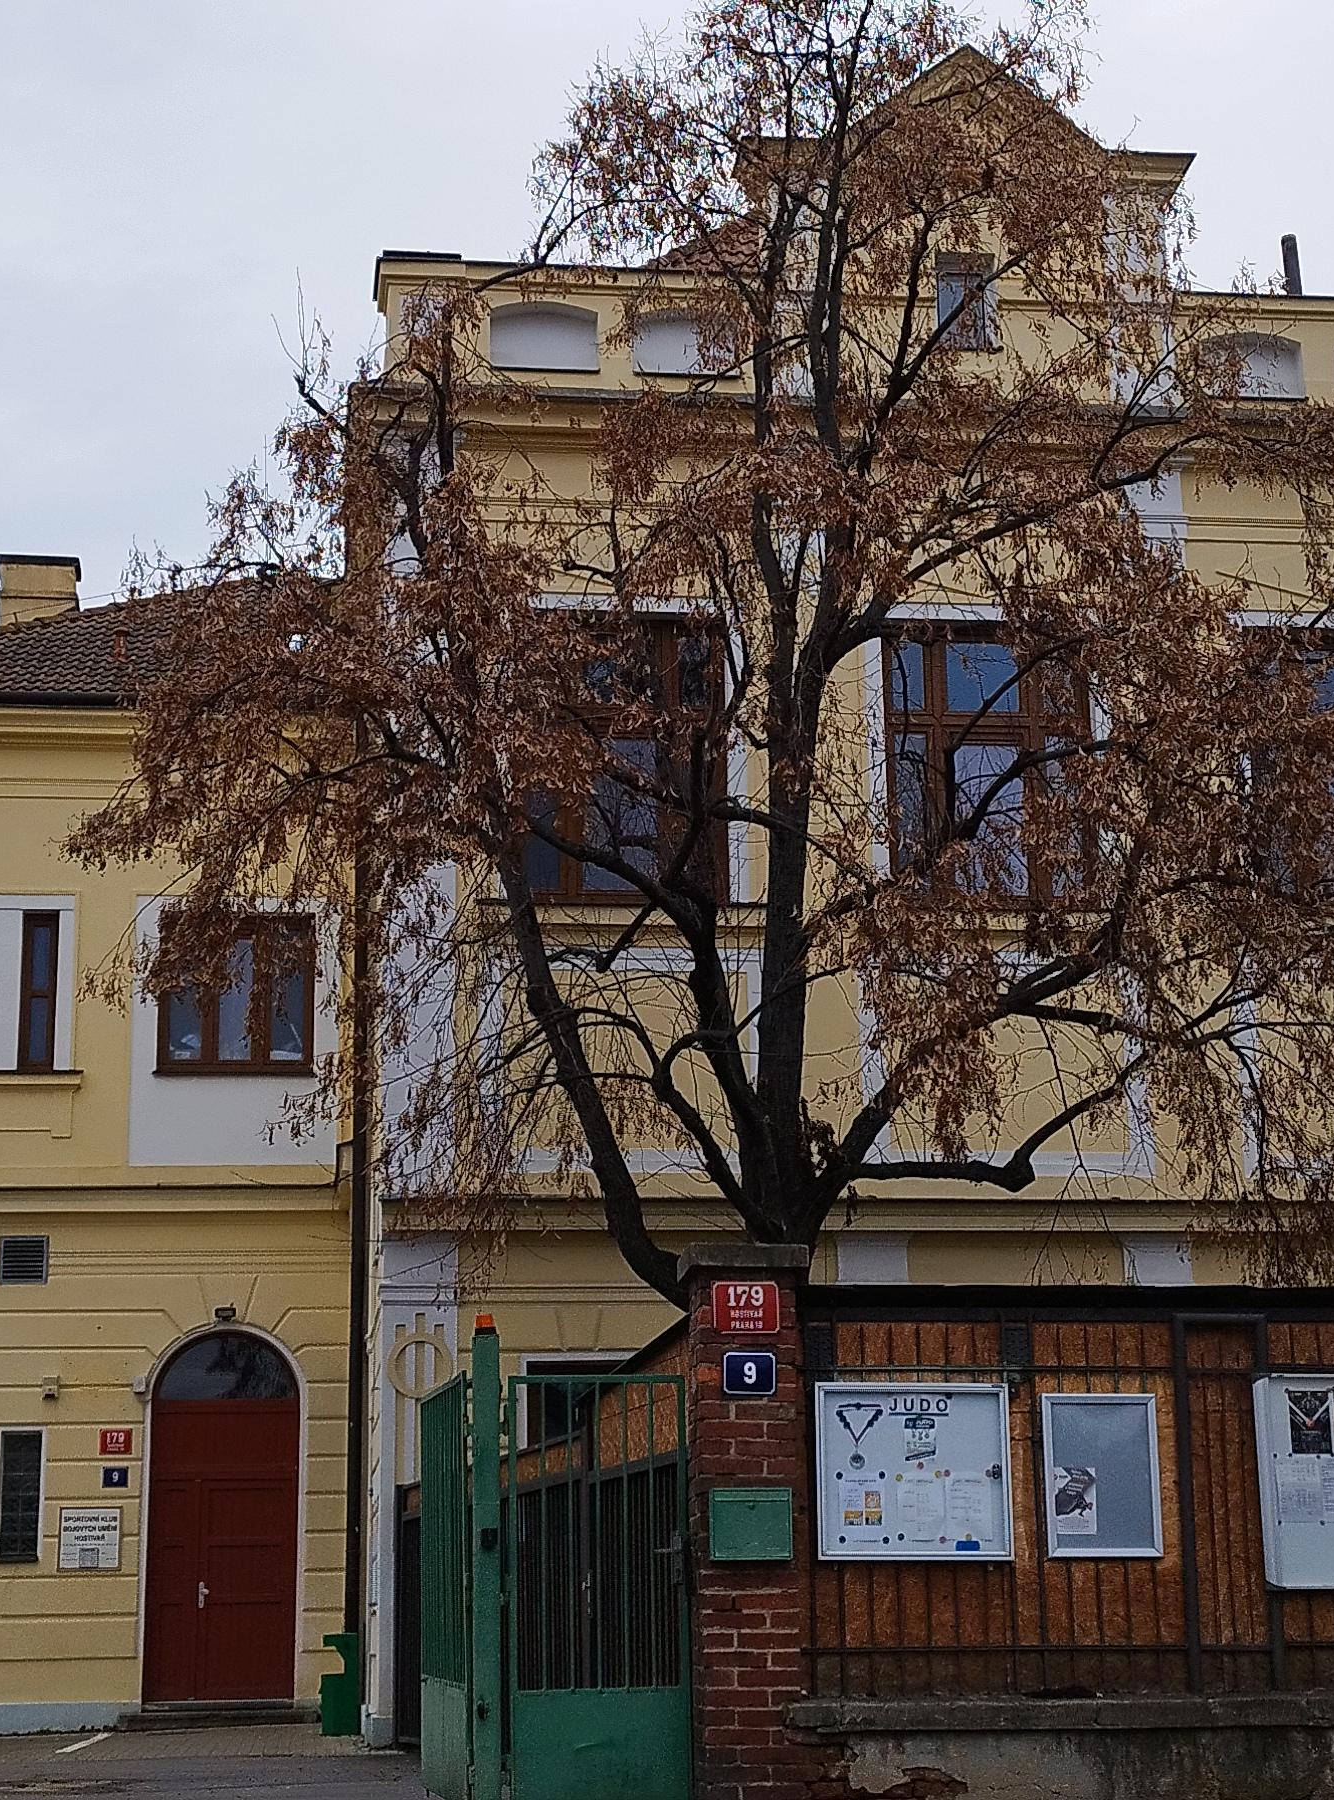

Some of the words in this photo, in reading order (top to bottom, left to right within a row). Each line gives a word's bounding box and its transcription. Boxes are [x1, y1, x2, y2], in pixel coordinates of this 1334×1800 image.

[727, 1286, 764, 1307] 179
[743, 1361, 757, 1385] 9
[888, 1398, 949, 1412] JUDO
[107, 1432, 125, 1444] 179
[112, 1471, 119, 1483] 9
